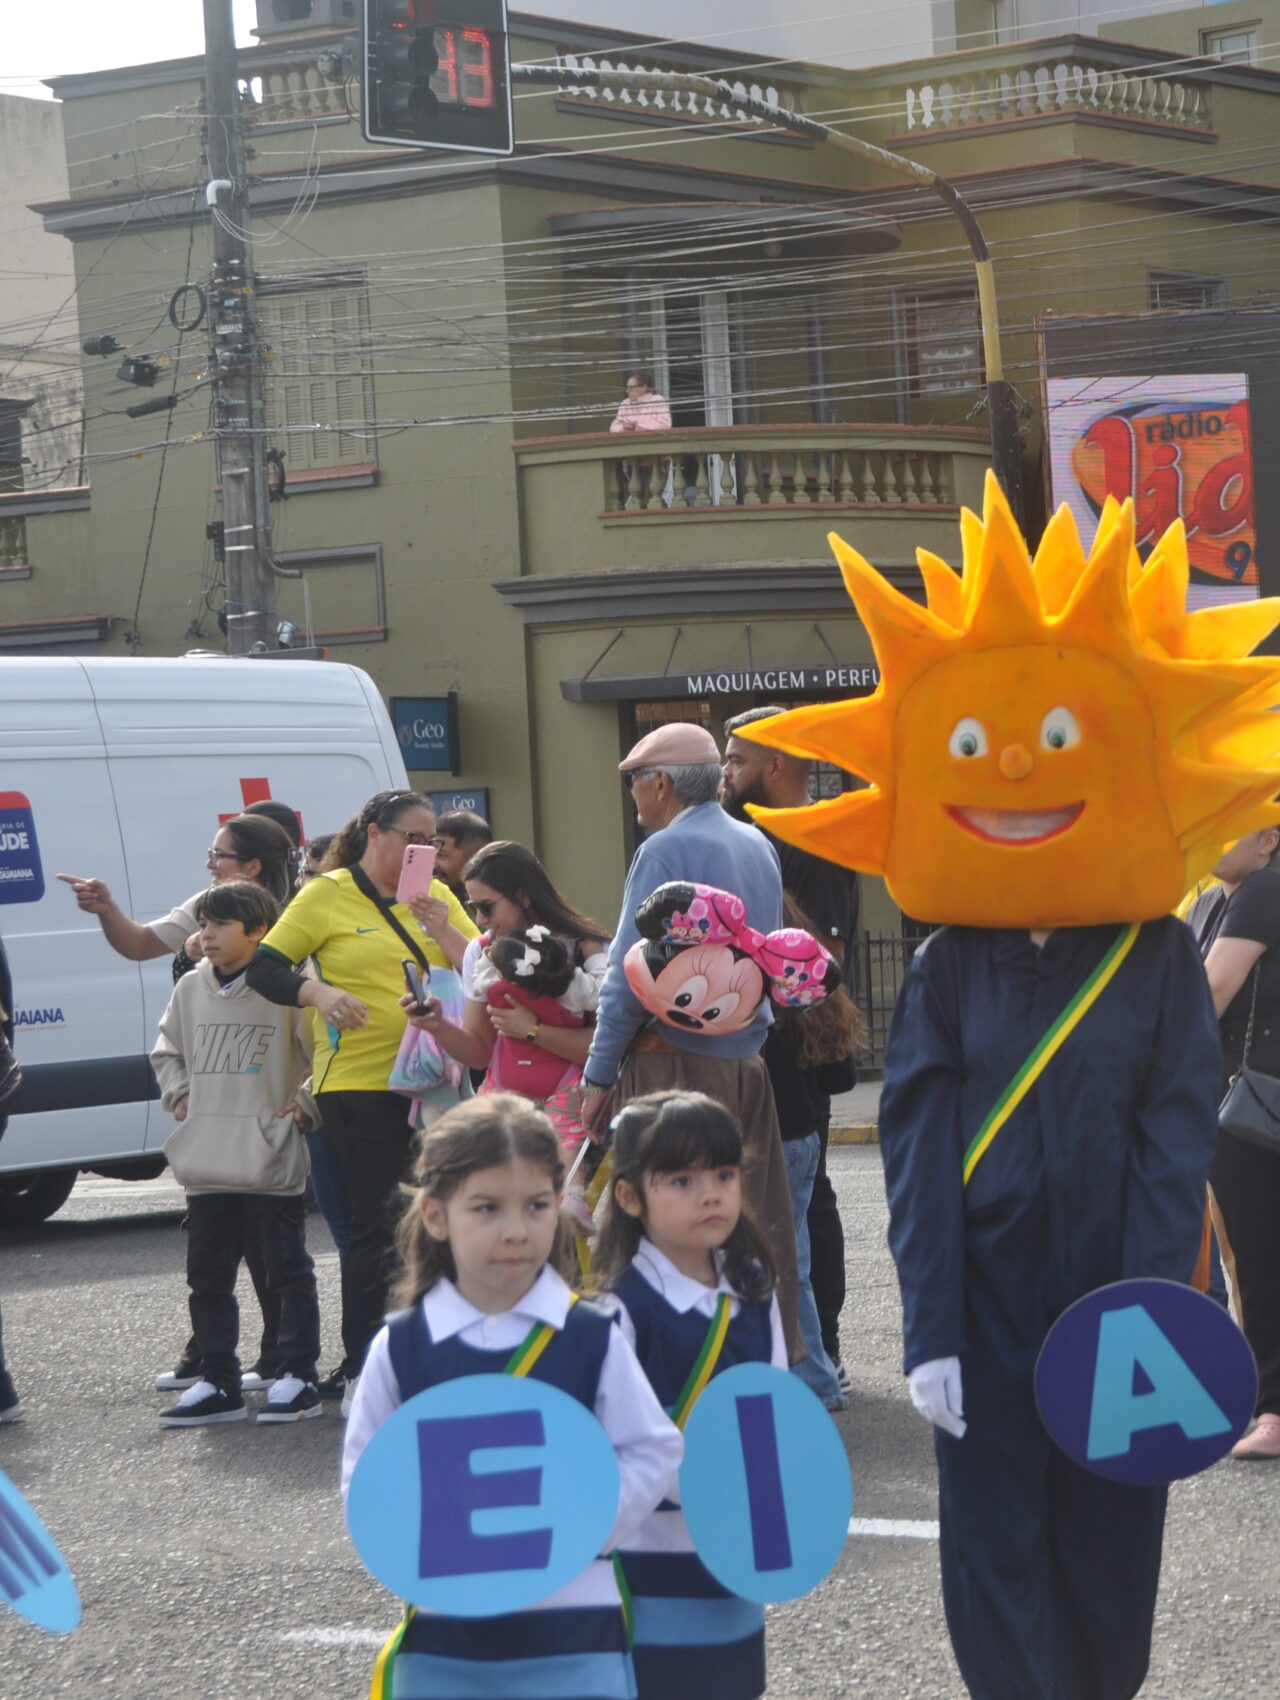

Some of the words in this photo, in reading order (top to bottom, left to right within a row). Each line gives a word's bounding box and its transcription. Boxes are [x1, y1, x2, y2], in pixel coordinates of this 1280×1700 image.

[687, 671, 805, 694] MAQUIAGEM
[413, 719, 444, 738] Geo
[452, 796, 475, 810] Geo
[193, 1024, 276, 1075] NIKE
[1087, 1304, 1233, 1460] A
[417, 1409, 553, 1579] E
[735, 1393, 793, 1572] I
